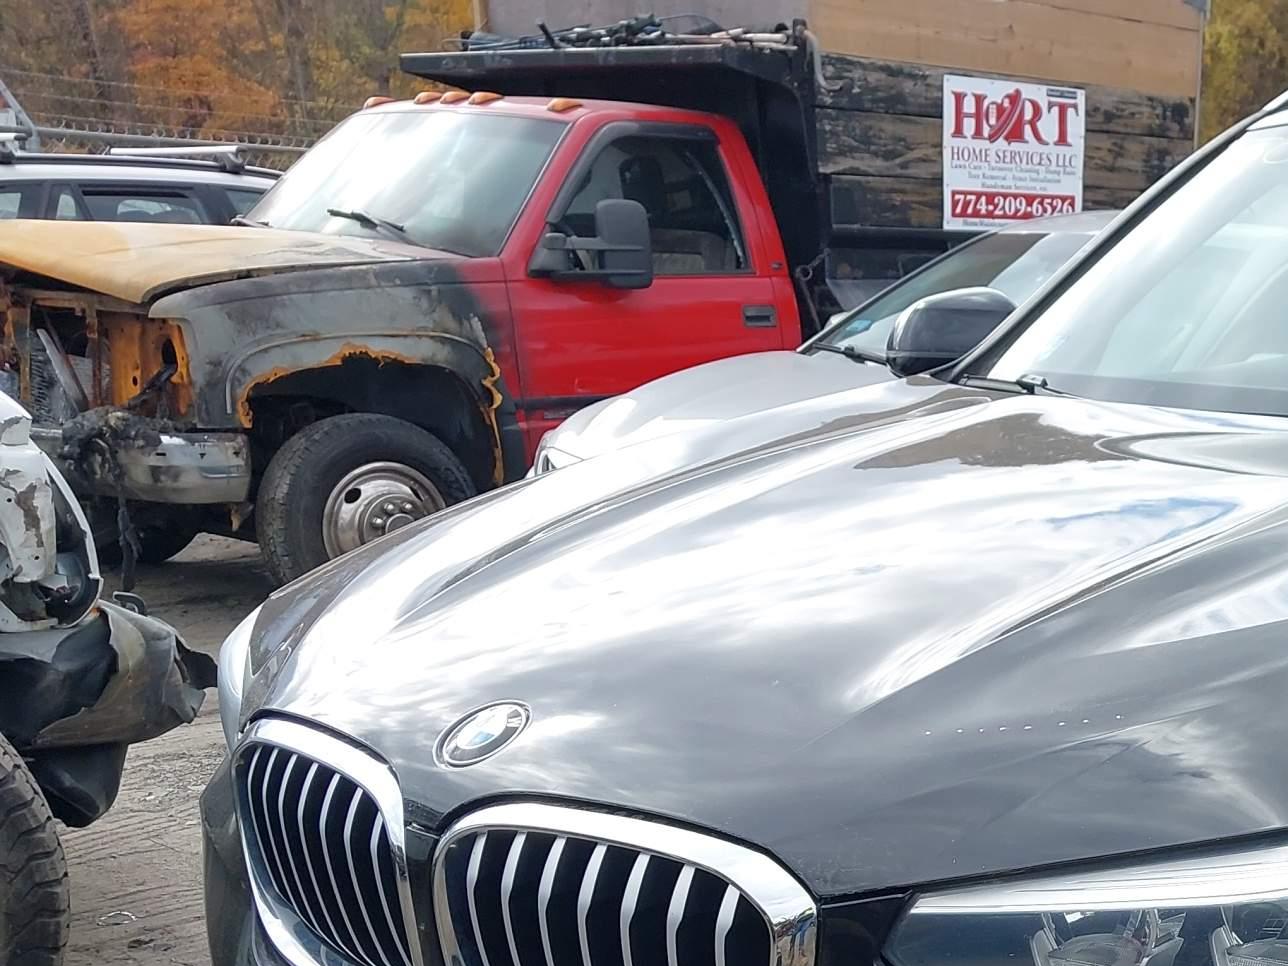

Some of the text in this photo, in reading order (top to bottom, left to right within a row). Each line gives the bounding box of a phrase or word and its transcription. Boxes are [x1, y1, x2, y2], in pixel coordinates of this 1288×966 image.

[951, 146, 1078, 169] HOME SERVICES LLC
[954, 194, 1073, 217] 774-209-6526
